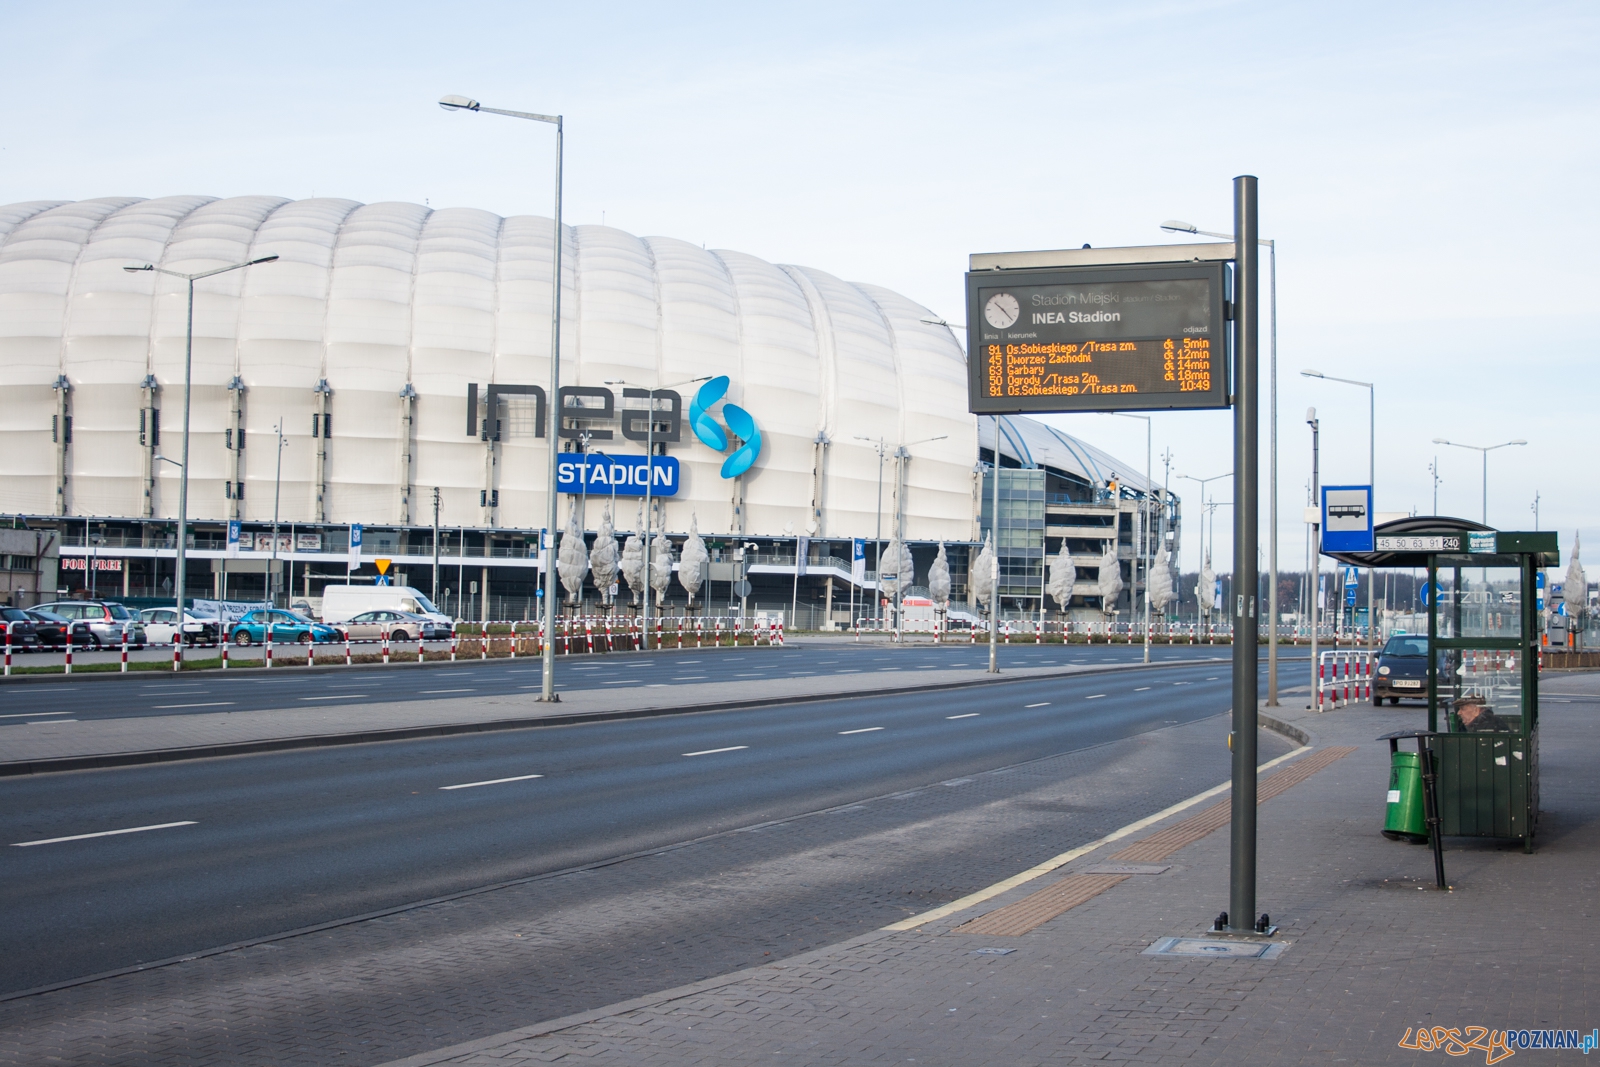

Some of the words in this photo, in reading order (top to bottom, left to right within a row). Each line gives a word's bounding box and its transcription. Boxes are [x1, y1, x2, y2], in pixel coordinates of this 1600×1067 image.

[1031, 294, 1077, 306] Stadion
[1080, 292, 1120, 306] Miejski
[1032, 312, 1066, 325] INEA
[1068, 311, 1121, 323] Stadion
[1183, 325, 1208, 334] odjazd
[988, 344, 1002, 355] 91
[1119, 342, 1137, 351] zm.
[988, 354, 1002, 366] 45
[1006, 354, 1047, 365] Dworzec
[1049, 352, 1092, 364] Zachodni
[988, 365, 1003, 376] 63
[1007, 365, 1045, 376] Garbary
[989, 376, 1003, 386] 50
[1007, 375, 1041, 386] Ogrody
[989, 386, 1003, 396] 91
[1120, 384, 1138, 393] zm.
[1180, 380, 1211, 391] 10:49
[557, 462, 673, 486] STADION
[1380, 539, 1390, 548] 45
[1396, 539, 1407, 548] 50
[1412, 539, 1423, 548] 63
[1429, 539, 1439, 548] 91
[1443, 538, 1459, 548] 240
[62, 558, 86, 570] FOR
[91, 559, 122, 571] FREE
[1460, 682, 1493, 698] ztm
